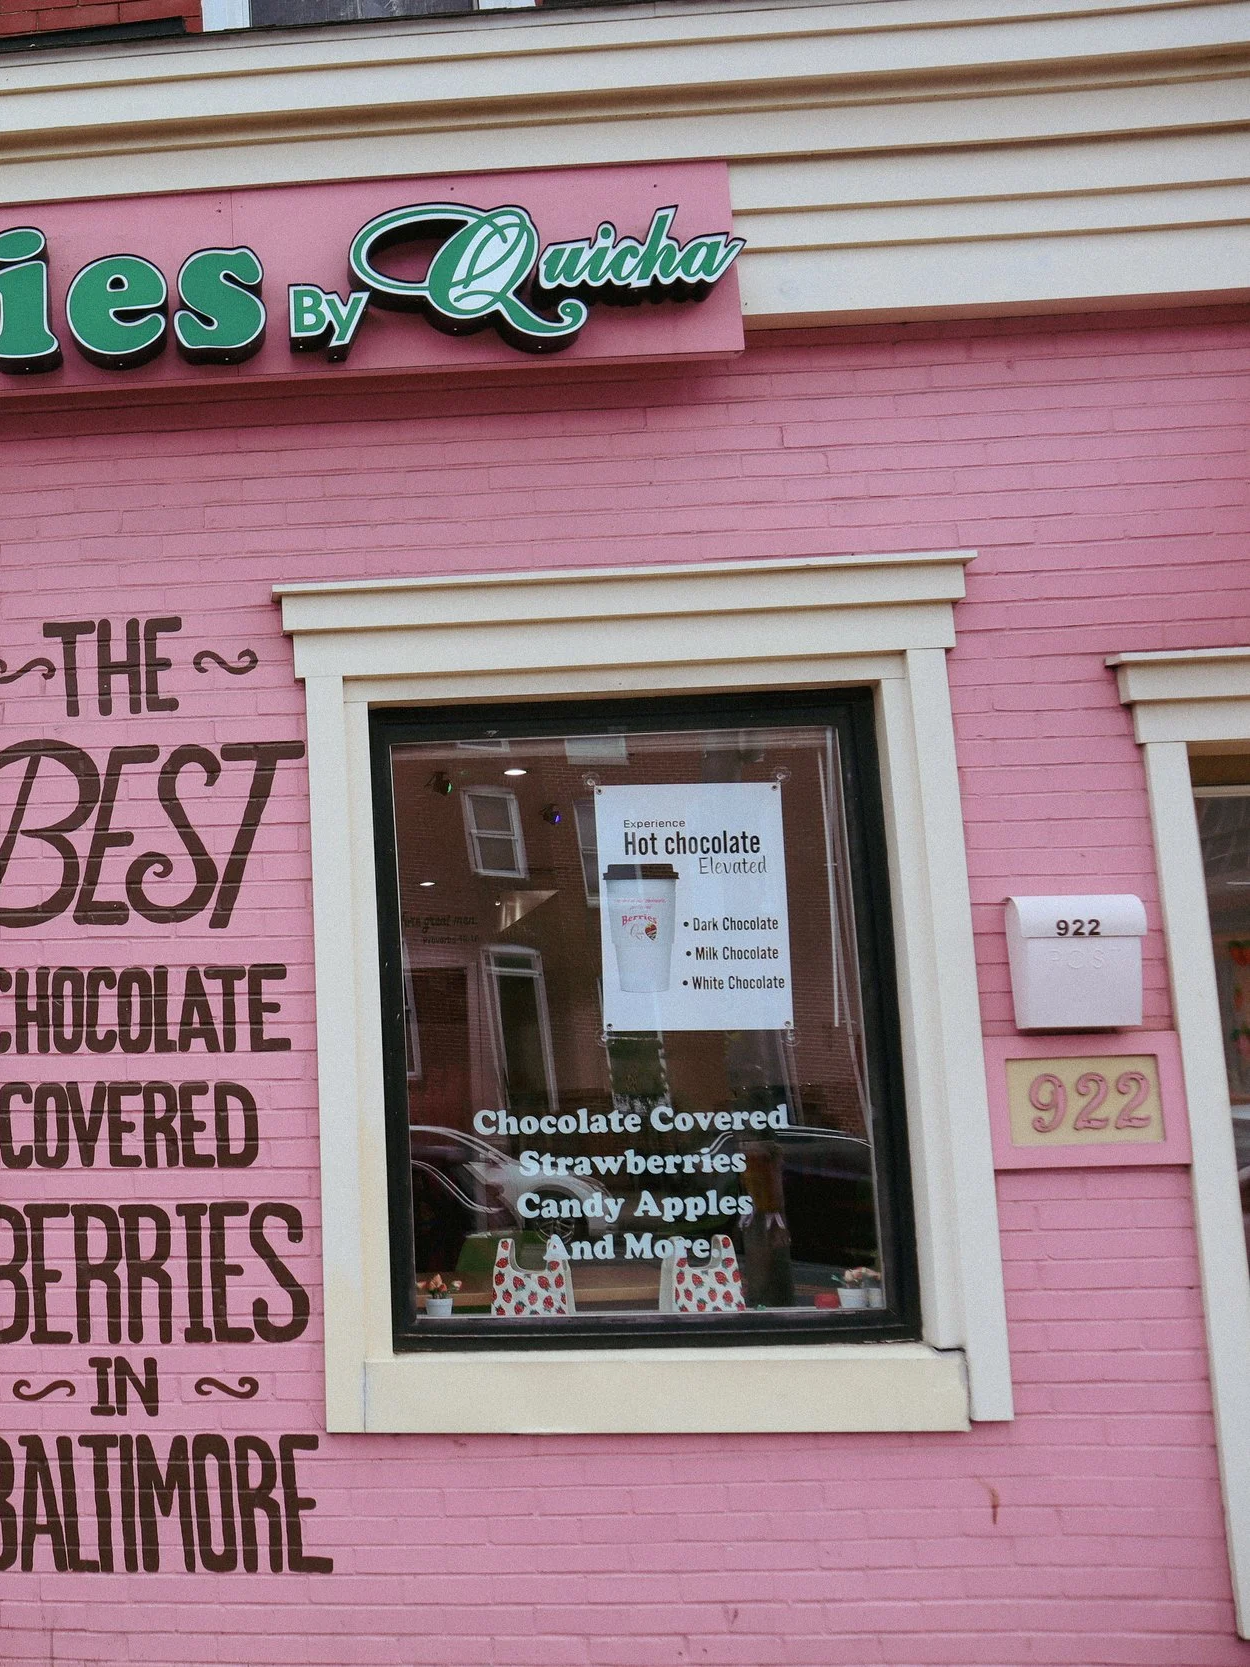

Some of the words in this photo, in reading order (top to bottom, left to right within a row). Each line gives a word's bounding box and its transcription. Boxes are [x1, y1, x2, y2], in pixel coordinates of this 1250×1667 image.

[287, 283, 370, 350] By
[349, 202, 746, 340] Quicha
[42, 616, 183, 718] THE
[623, 819, 686, 829] Experience
[624, 831, 658, 856] Hot
[664, 830, 761, 855] chocolate
[699, 856, 767, 875] Elevated
[693, 917, 718, 931] Dark
[722, 916, 779, 931] Chocolate
[1056, 918, 1101, 936] 922
[695, 946, 718, 960] Milk
[722, 946, 779, 960] Chocolate
[692, 976, 724, 990] White
[728, 975, 785, 990] Chocolate
[1028, 1070, 1152, 1134] 922
[473, 1108, 642, 1136] Chocolate
[650, 1103, 790, 1132] Covered
[518, 1147, 747, 1177] Strawberries
[516, 1192, 625, 1223] Candy
[633, 1190, 753, 1222] Apples
[543, 1233, 616, 1260] And
[623, 1232, 721, 1260] More.
[88, 1356, 160, 1417] IN
